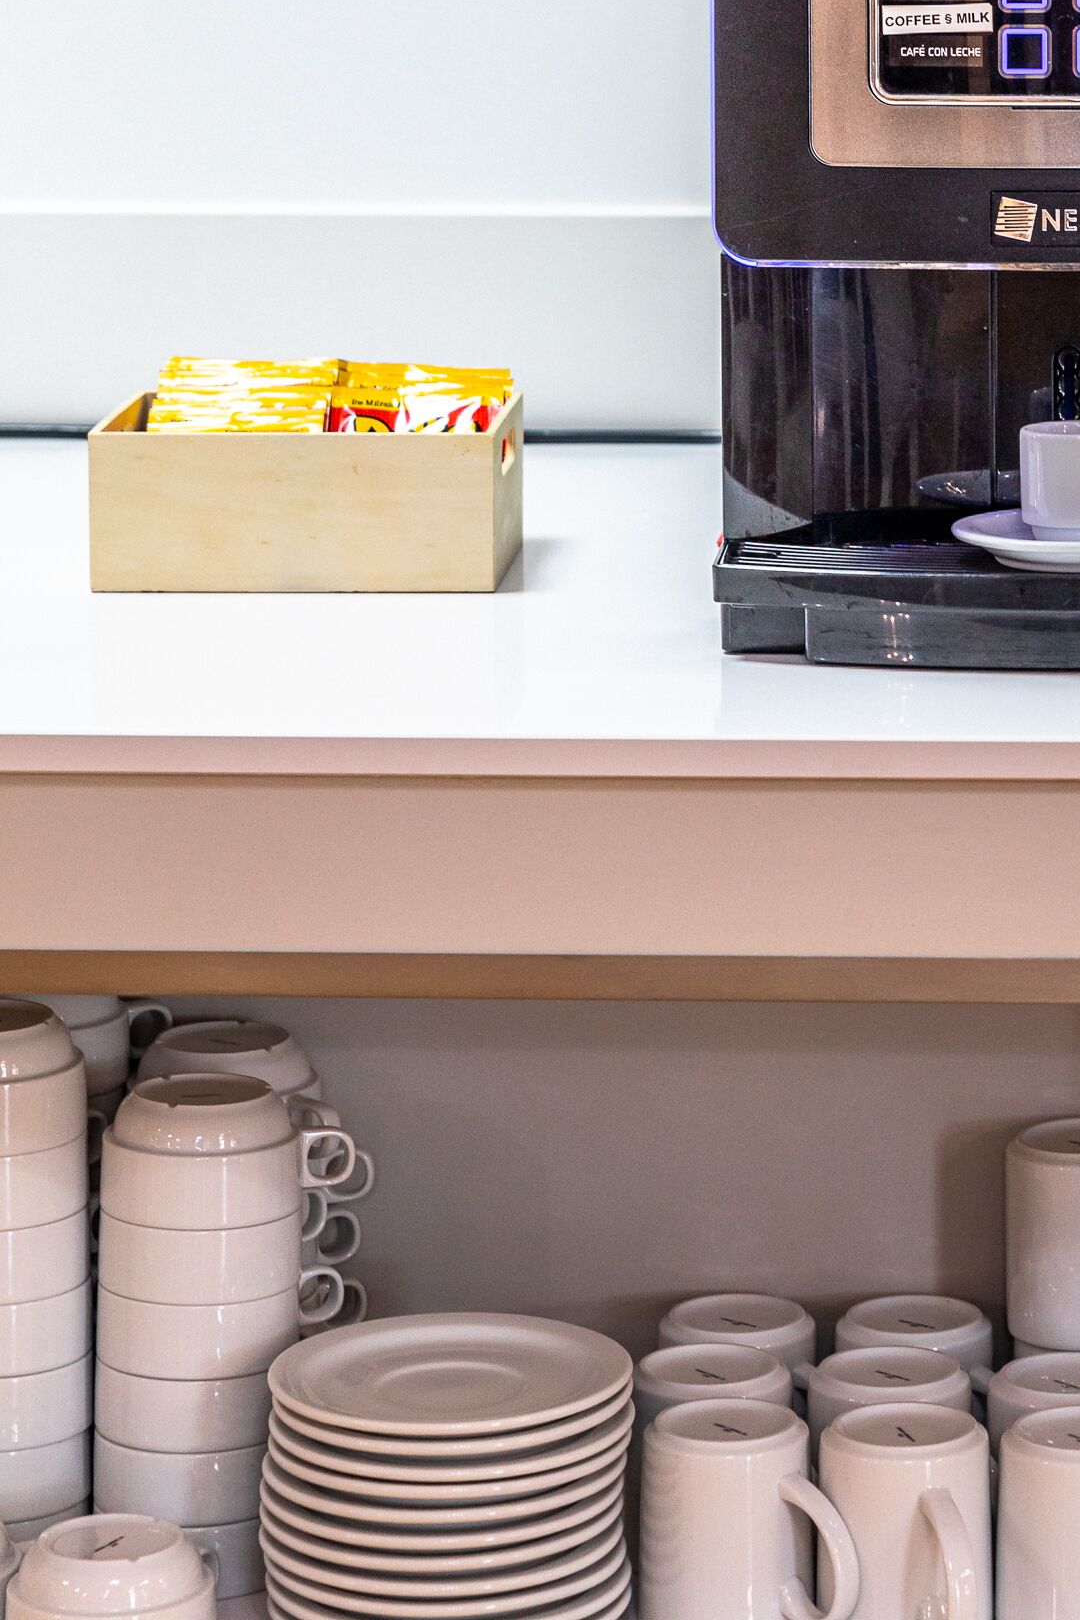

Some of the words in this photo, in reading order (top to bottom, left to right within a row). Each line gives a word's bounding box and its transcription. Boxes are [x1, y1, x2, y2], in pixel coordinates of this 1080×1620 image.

[885, 14, 941, 26] COFFEE
[956, 12, 990, 24] MILK
[900, 44, 926, 56] CAFÉ
[928, 47, 948, 57] CON
[950, 47, 981, 57] LECHE
